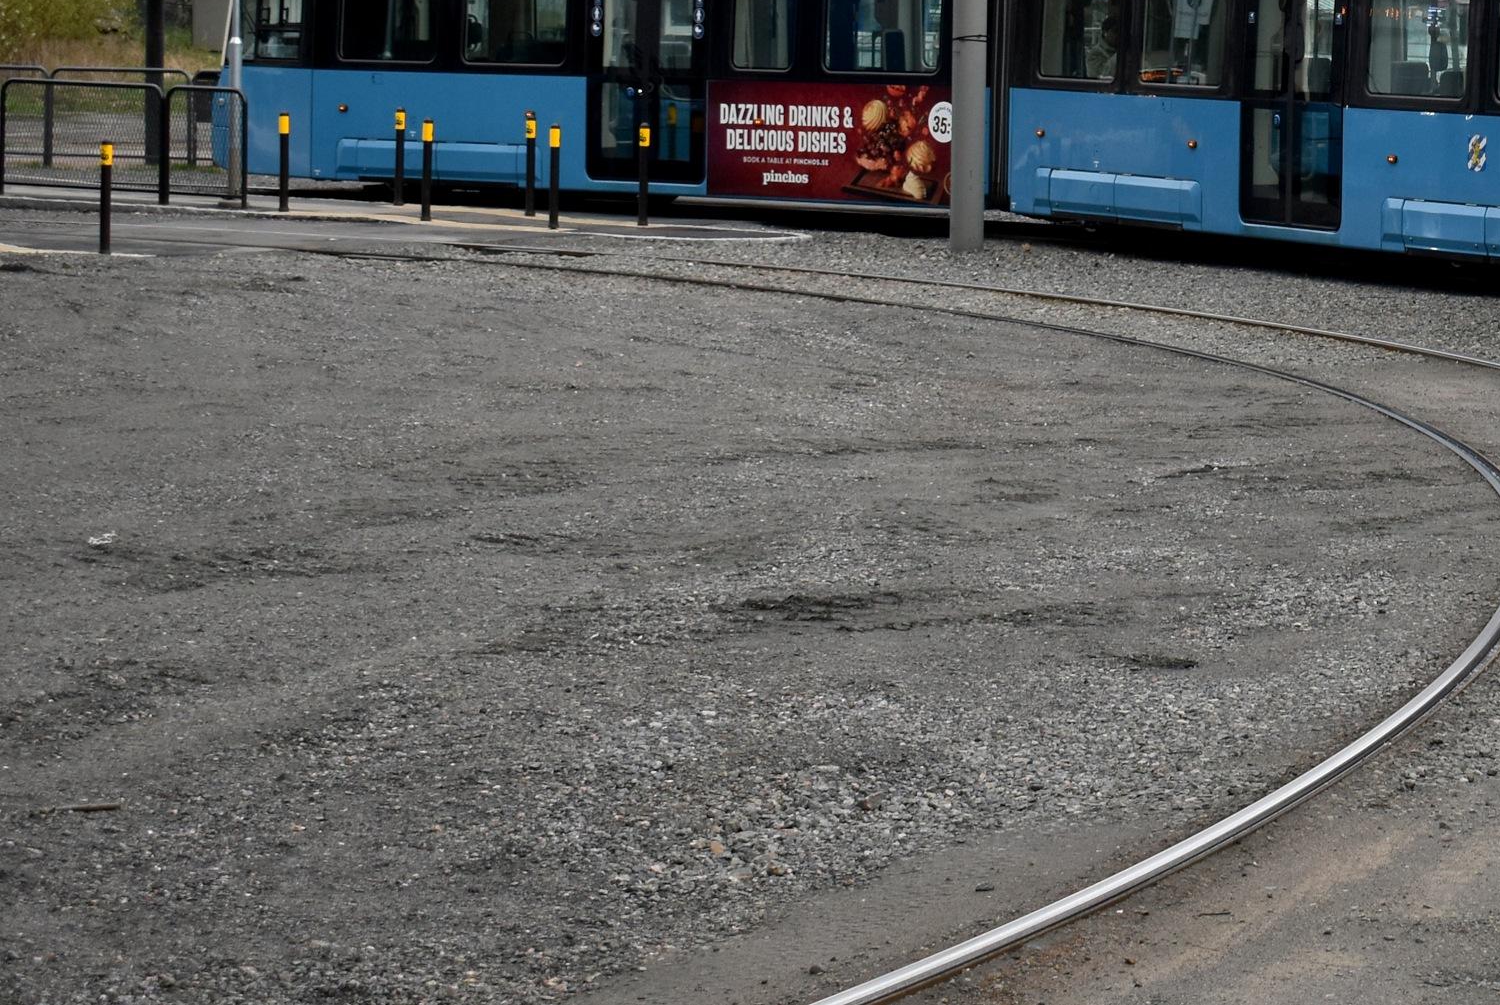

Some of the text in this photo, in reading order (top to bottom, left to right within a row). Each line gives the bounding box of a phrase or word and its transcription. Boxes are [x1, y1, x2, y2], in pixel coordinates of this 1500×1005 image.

[720, 103, 854, 128] DAZZLING DRINKS &
[726, 129, 847, 154] DELICIOUS DISHES
[793, 158, 829, 166] PINCHOS.SE
[762, 169, 809, 185] pinchos
